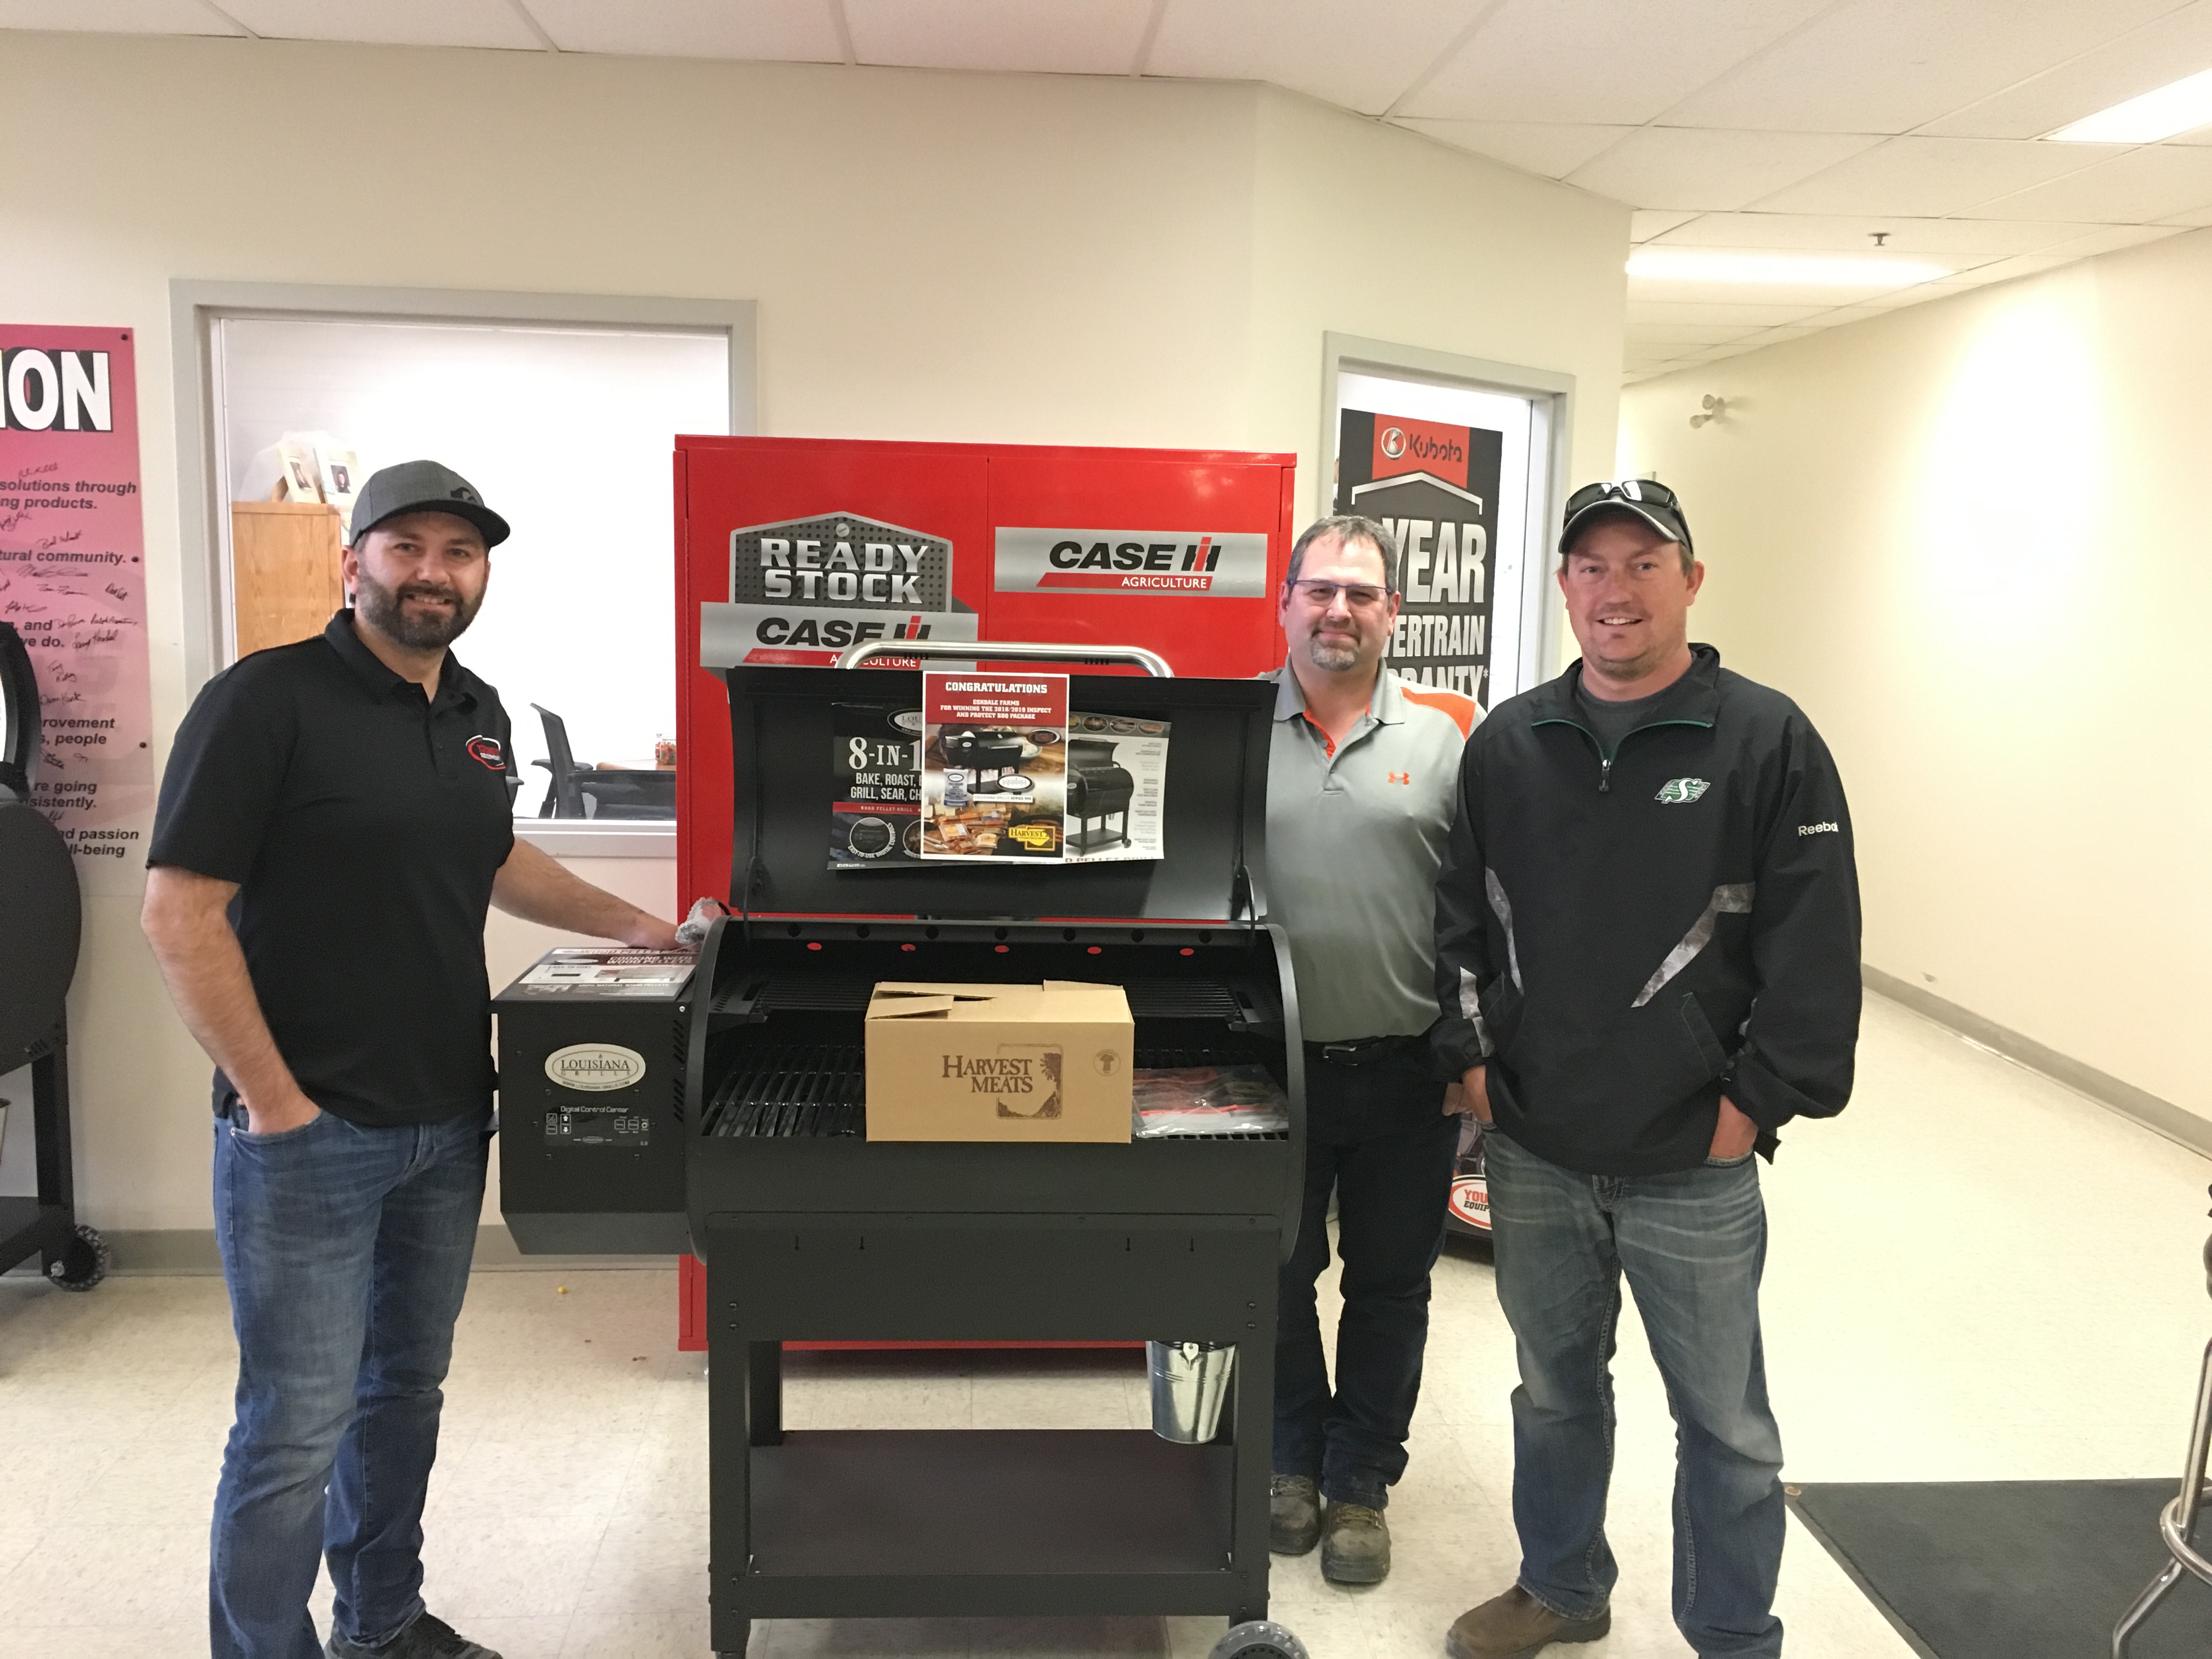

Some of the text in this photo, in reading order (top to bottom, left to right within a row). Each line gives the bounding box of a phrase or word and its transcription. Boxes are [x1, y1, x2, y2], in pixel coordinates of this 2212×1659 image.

[1409, 434, 1462, 462] Kubota
[0, 479, 137, 496] solutions through
[24, 496, 97, 510] products.
[37, 552, 126, 566] community.
[760, 538, 928, 573] READY
[1049, 540, 1177, 571] CASE
[764, 569, 923, 603] STOCK
[1121, 577, 1207, 589] AGRICULTURE
[24, 619, 53, 631] and
[755, 617, 885, 648] CASE
[41, 636, 65, 647] do.
[945, 681, 1047, 693] CONGRATULATIONS
[42, 718, 115, 729] rovement
[55, 733, 106, 746] people
[856, 772, 883, 786] BAKE,
[885, 774, 916, 787] ROAST,
[54, 780, 97, 794] going
[851, 787, 878, 800] GRILL,
[881, 788, 907, 802] SEAR,
[78, 827, 139, 841] passion
[1011, 828, 1043, 837] HARVEST
[561, 1060, 629, 1069] LOUISIANA
[942, 1055, 1032, 1077] HARVEST
[971, 1076, 1033, 1093] MEATS
[1464, 1189, 1488, 1204] YOU
